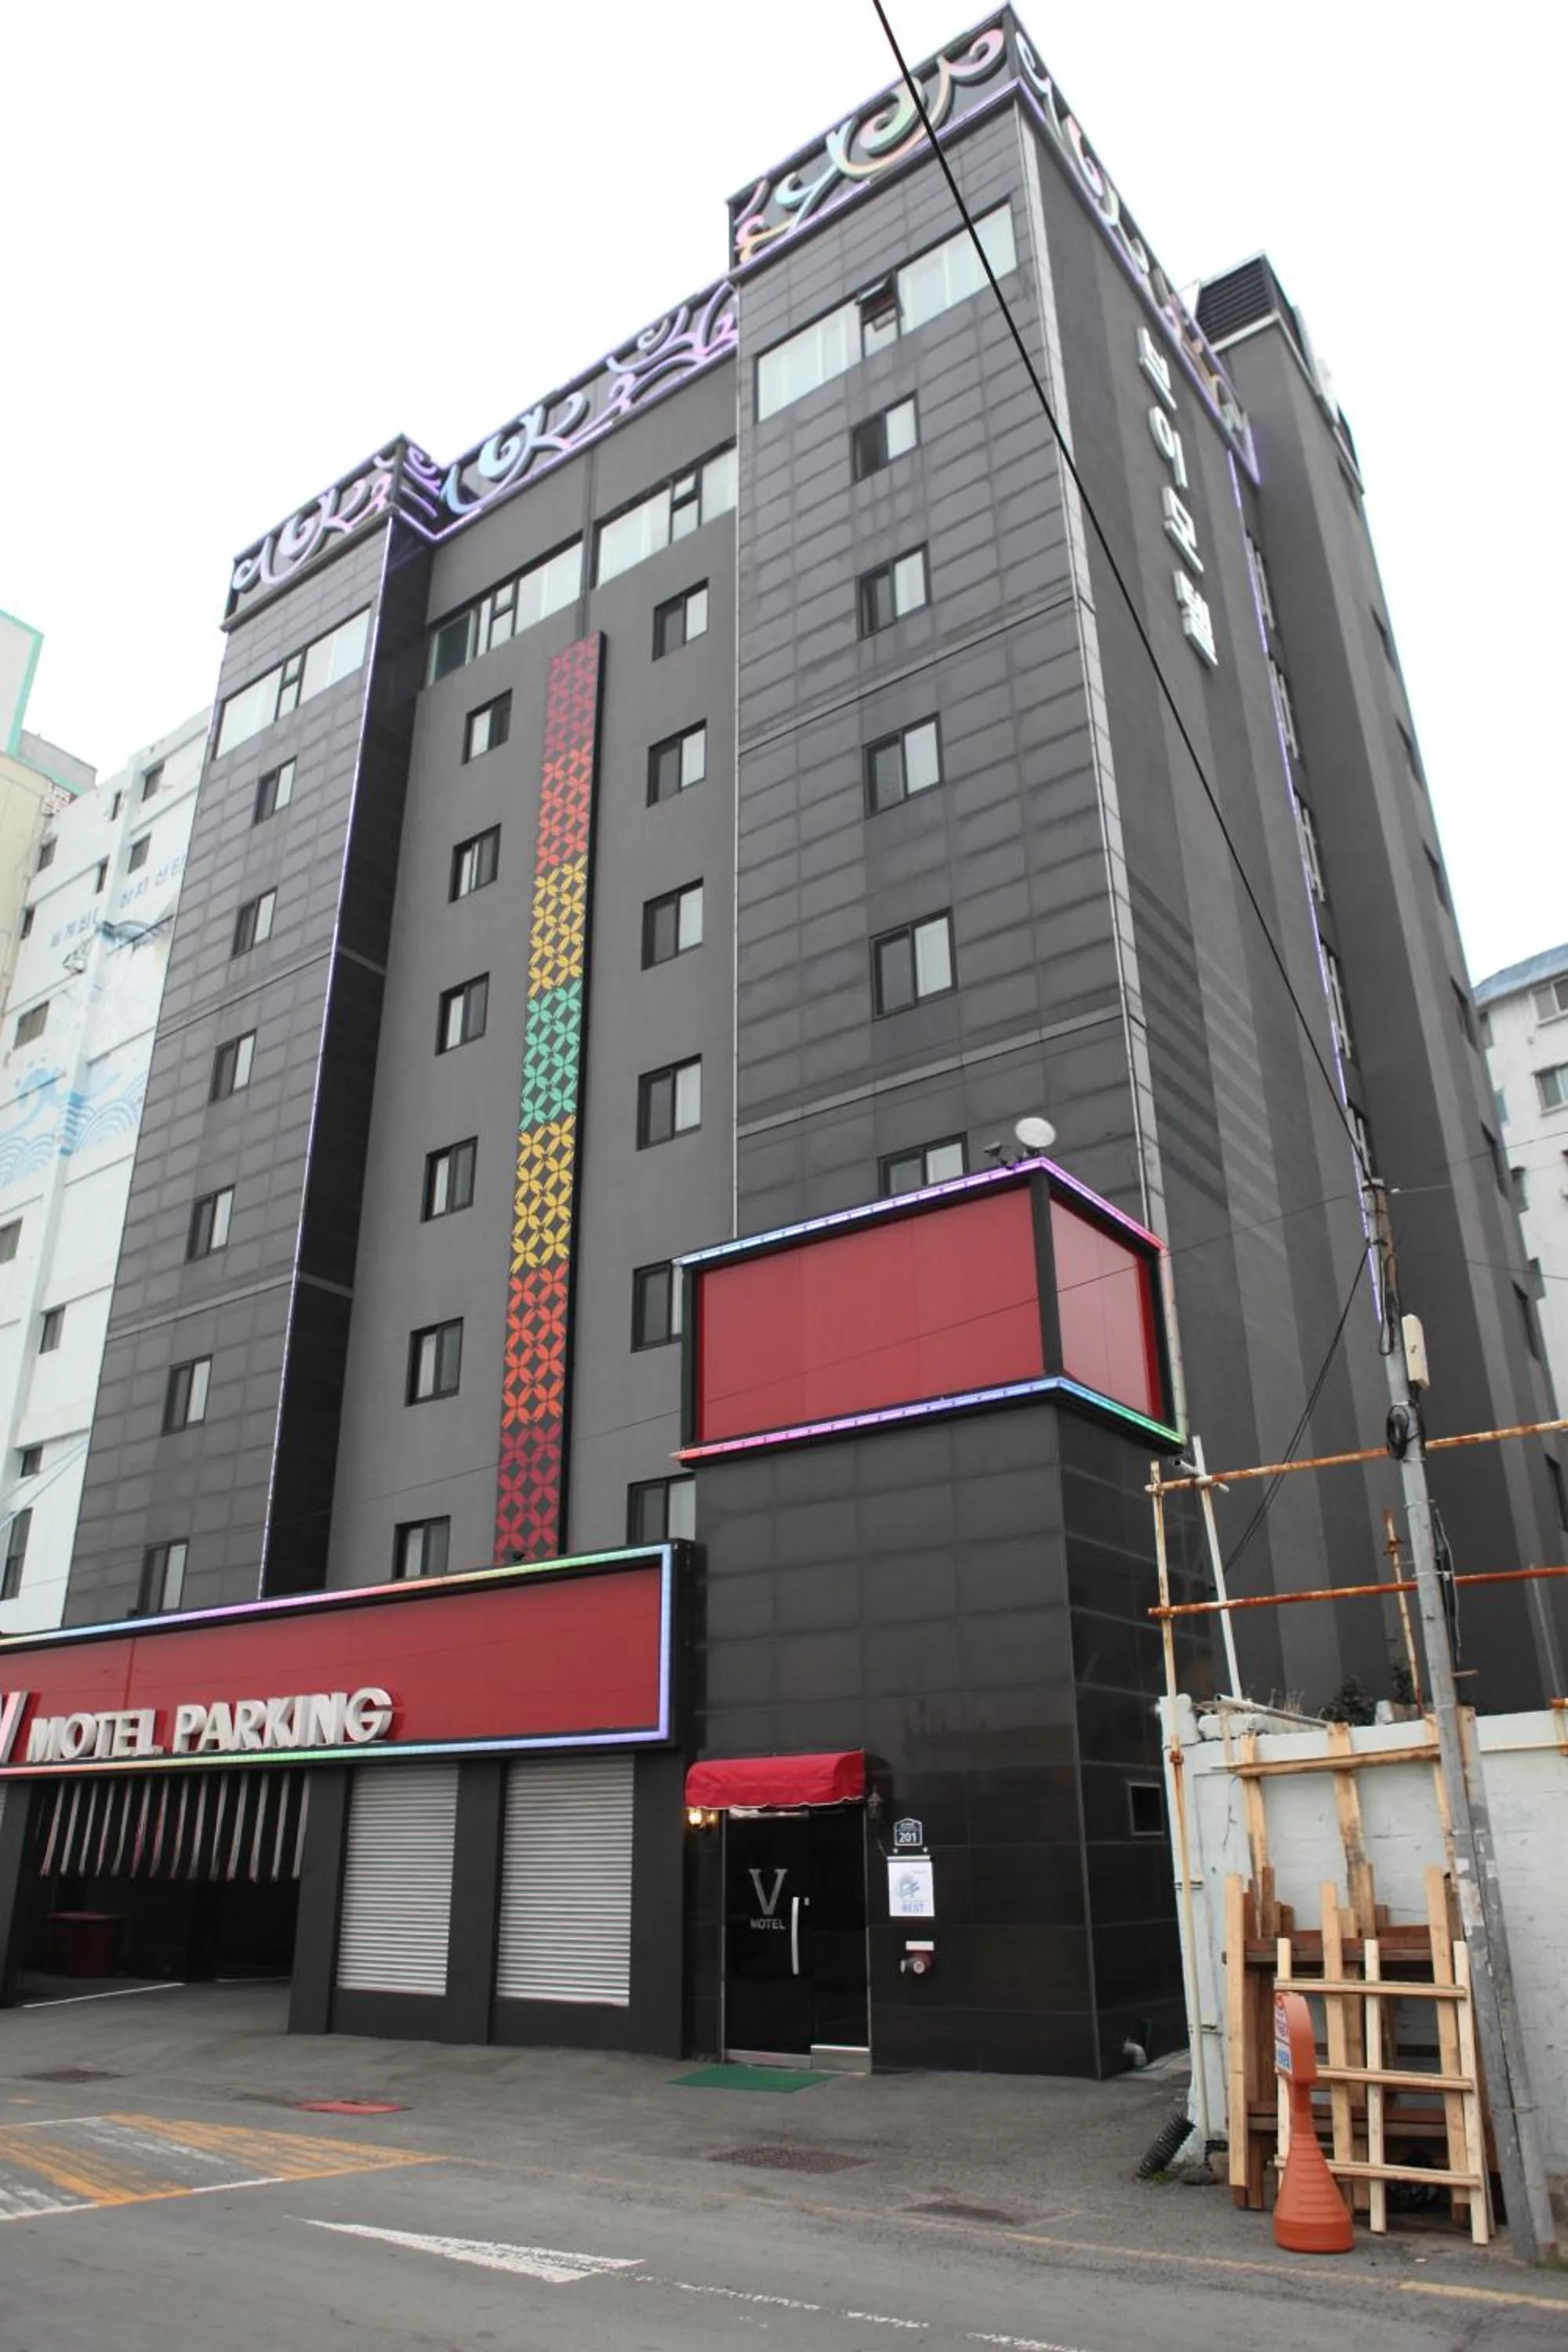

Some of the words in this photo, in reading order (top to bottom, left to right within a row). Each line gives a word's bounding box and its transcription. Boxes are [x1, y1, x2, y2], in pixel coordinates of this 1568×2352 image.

[1136, 326, 1218, 668] 브이모텔
[26, 1708, 162, 1762] MOTEL
[172, 1686, 394, 1754] PARKING
[899, 1832, 916, 1843] 201
[749, 1868, 788, 1915] V
[750, 1918, 786, 1929] MOTEL
